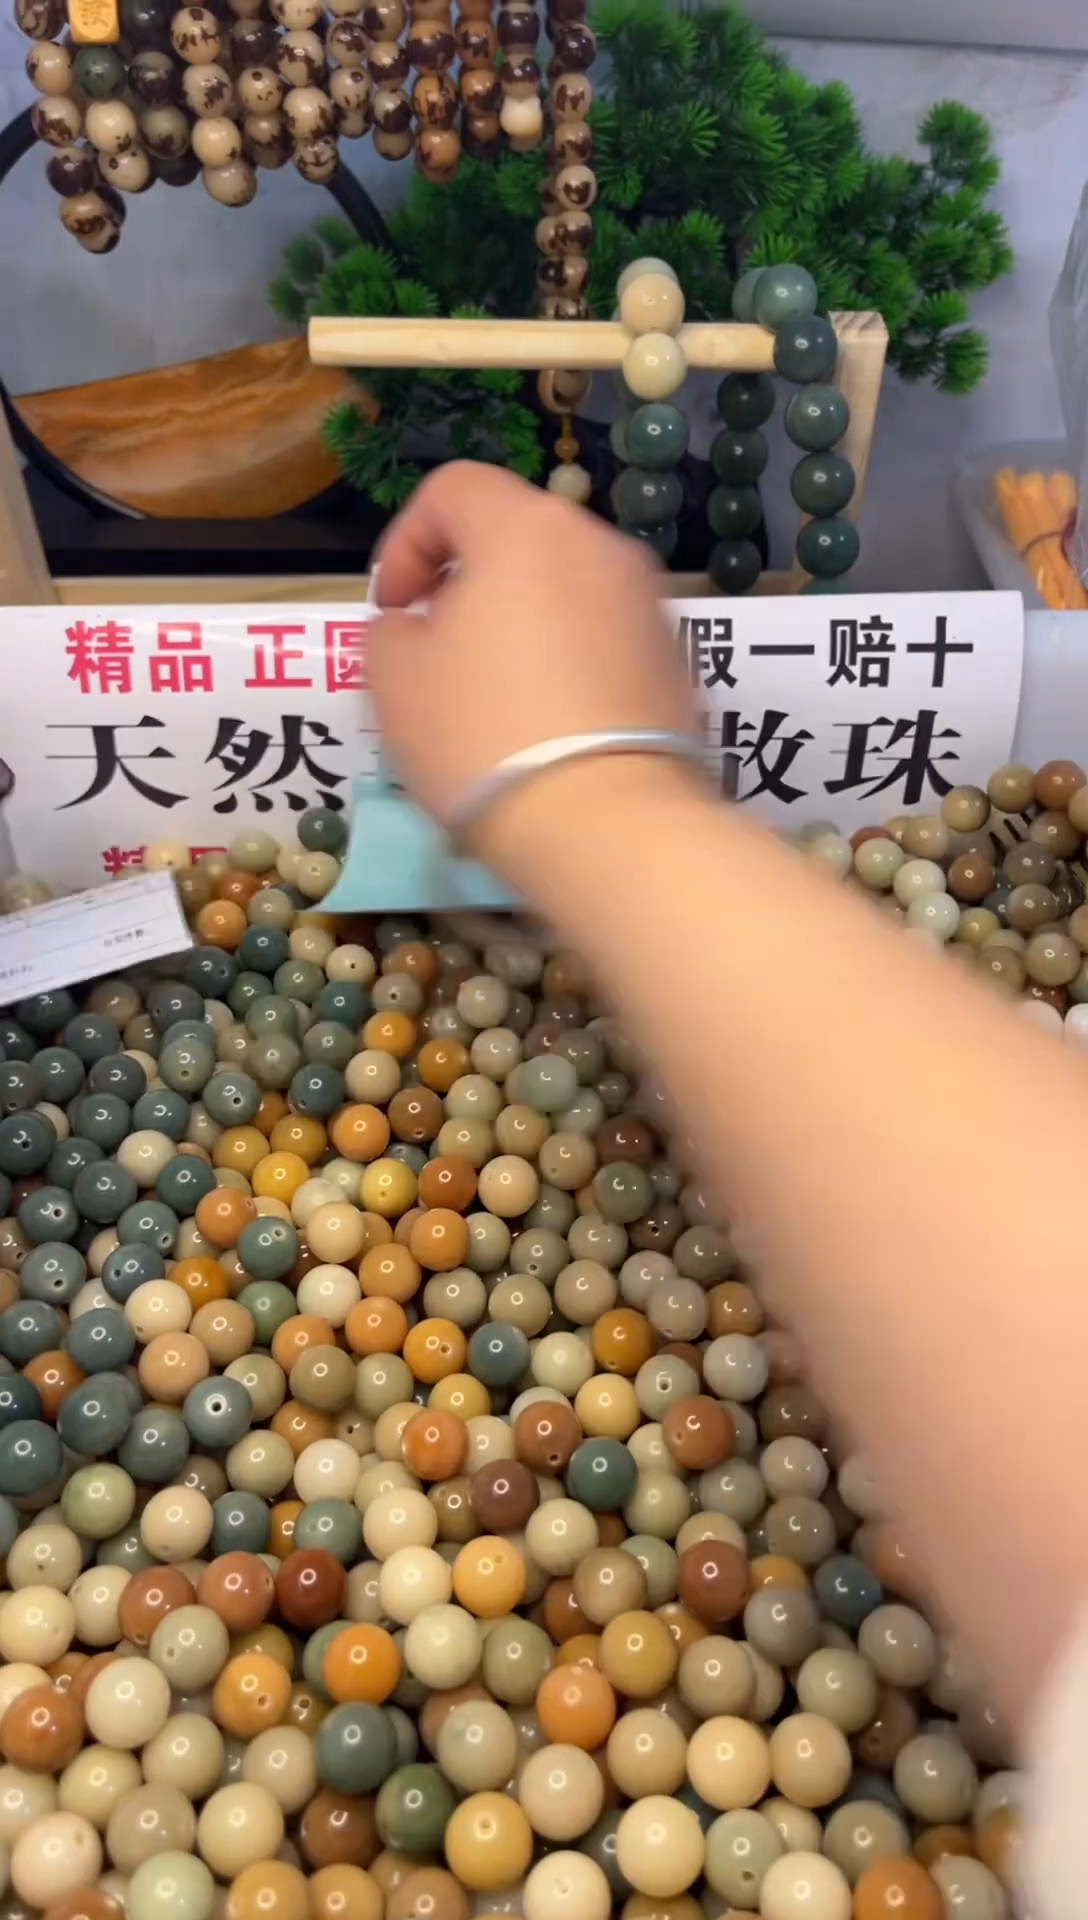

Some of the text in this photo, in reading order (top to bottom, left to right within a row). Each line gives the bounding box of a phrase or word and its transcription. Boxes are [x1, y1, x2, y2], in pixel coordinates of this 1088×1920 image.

[65, 620, 214, 694] 精品
[679, 615, 974, 689] 假一赔十
[45, 715, 404, 814] 天然
[703, 709, 963, 805] 散珠
